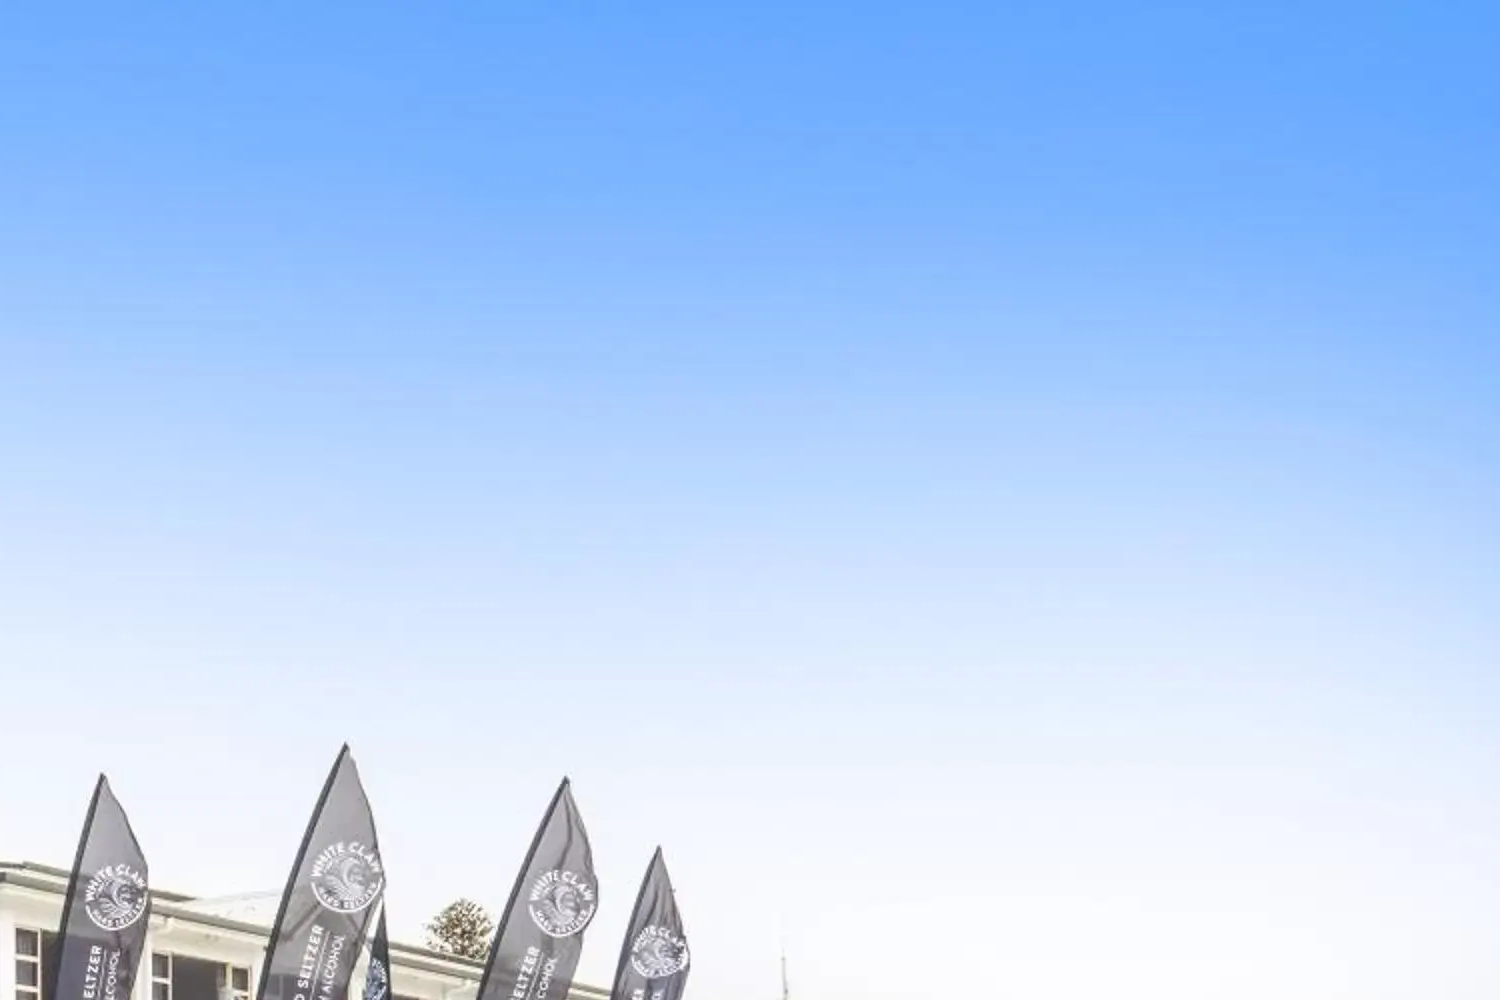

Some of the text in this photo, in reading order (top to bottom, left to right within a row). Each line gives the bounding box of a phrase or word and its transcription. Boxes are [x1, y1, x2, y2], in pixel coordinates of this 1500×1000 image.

[311, 842, 345, 877] WHITE
[86, 864, 148, 901] WHITE CLAW
[530, 870, 594, 901] WHITE CLAW
[298, 924, 324, 989] SELTZER
[321, 934, 346, 996] ALCOHOL
